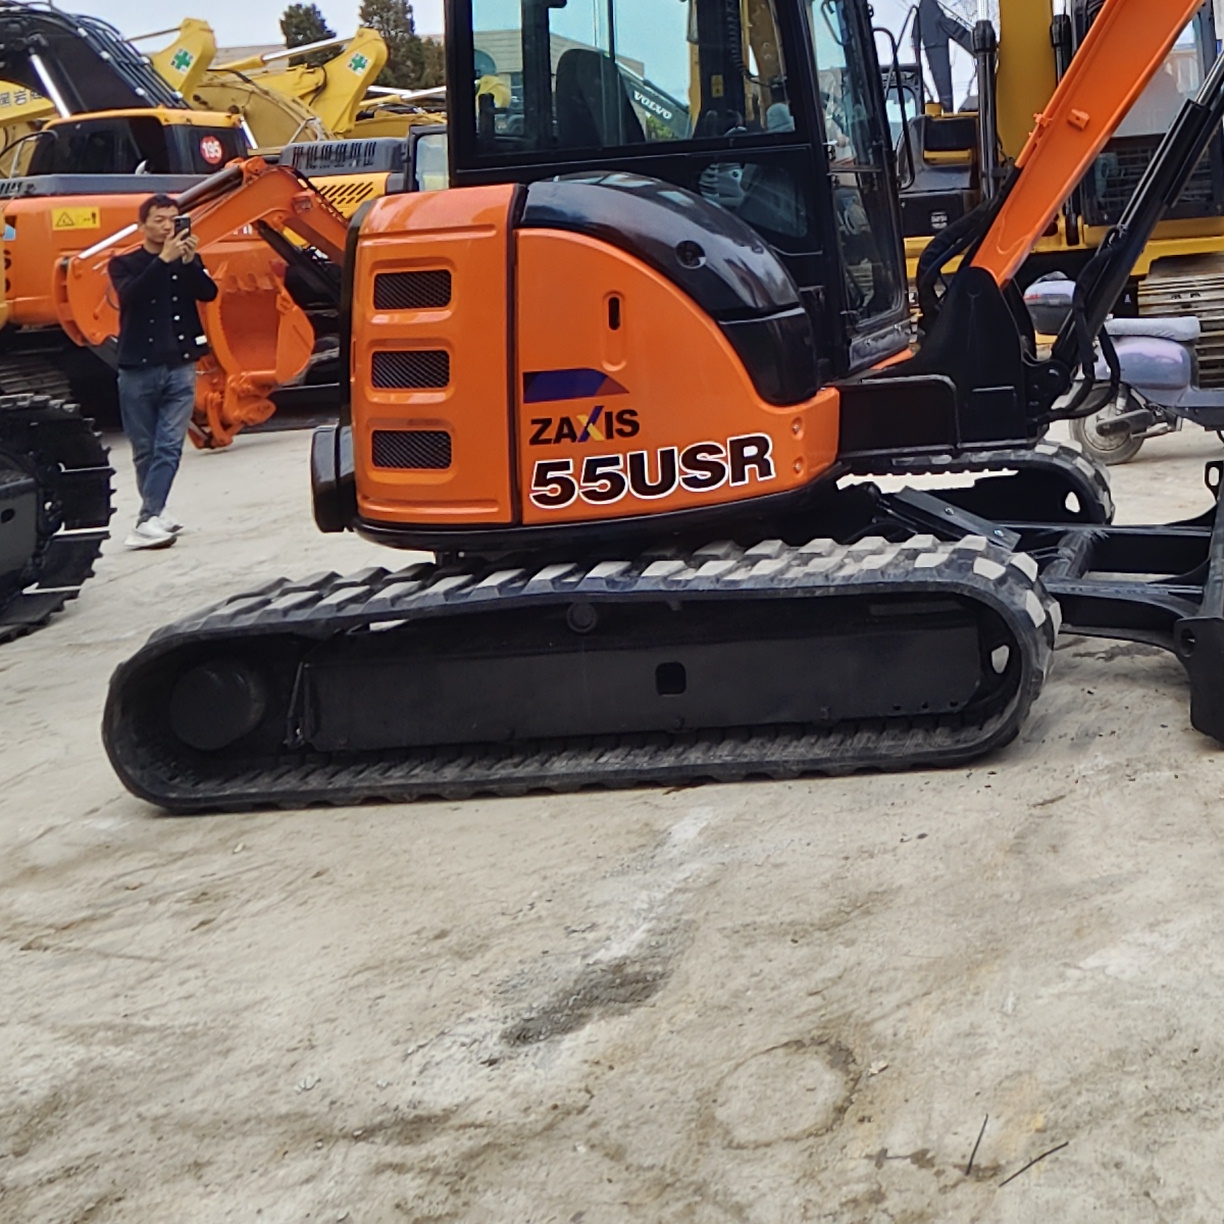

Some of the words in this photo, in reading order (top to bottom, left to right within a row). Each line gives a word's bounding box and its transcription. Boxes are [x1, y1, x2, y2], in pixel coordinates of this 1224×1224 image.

[633, 90, 673, 120] VOLVO
[529, 405, 641, 446] ZAXIS
[529, 432, 777, 509] 55USR
